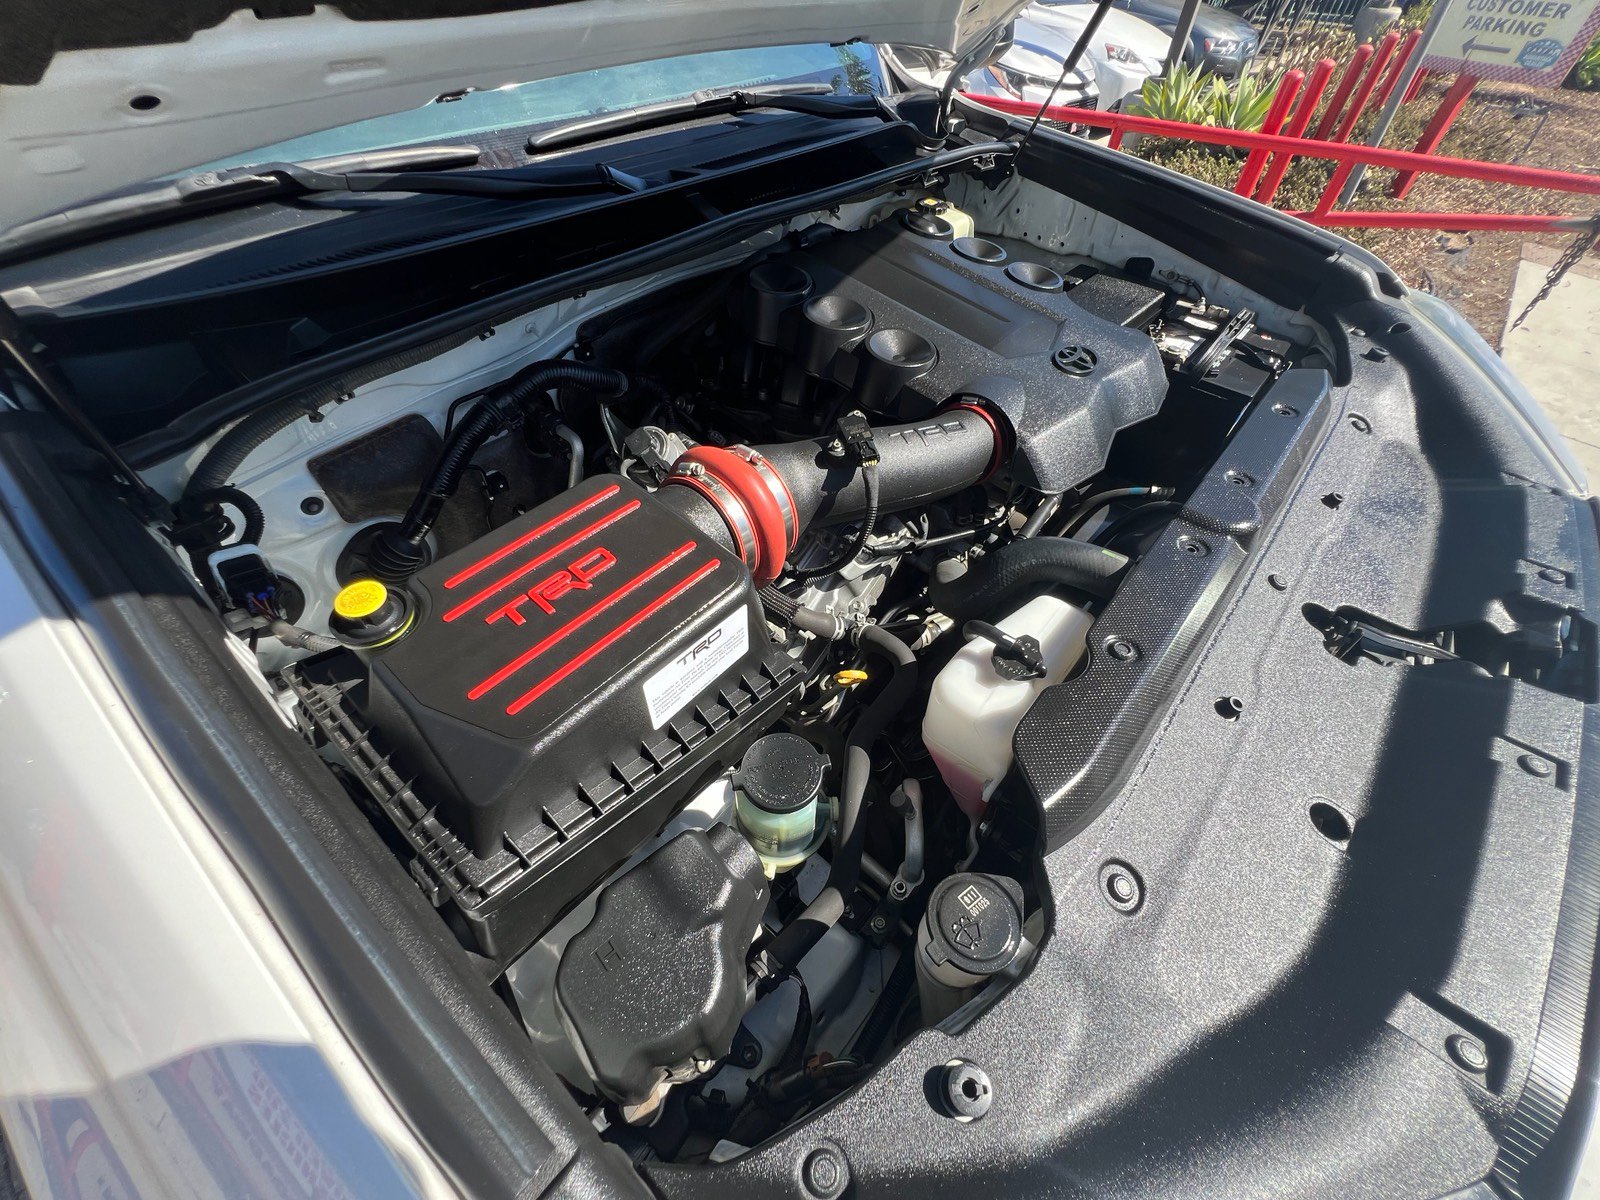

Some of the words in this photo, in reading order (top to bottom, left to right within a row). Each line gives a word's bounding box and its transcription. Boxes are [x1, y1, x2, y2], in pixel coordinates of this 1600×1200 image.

[1467, 0, 1571, 19] CUSTOMER
[1462, 15, 1547, 37] PARKING
[888, 421, 968, 447] TRD
[485, 547, 617, 626] TRD
[677, 628, 722, 665] TRD
